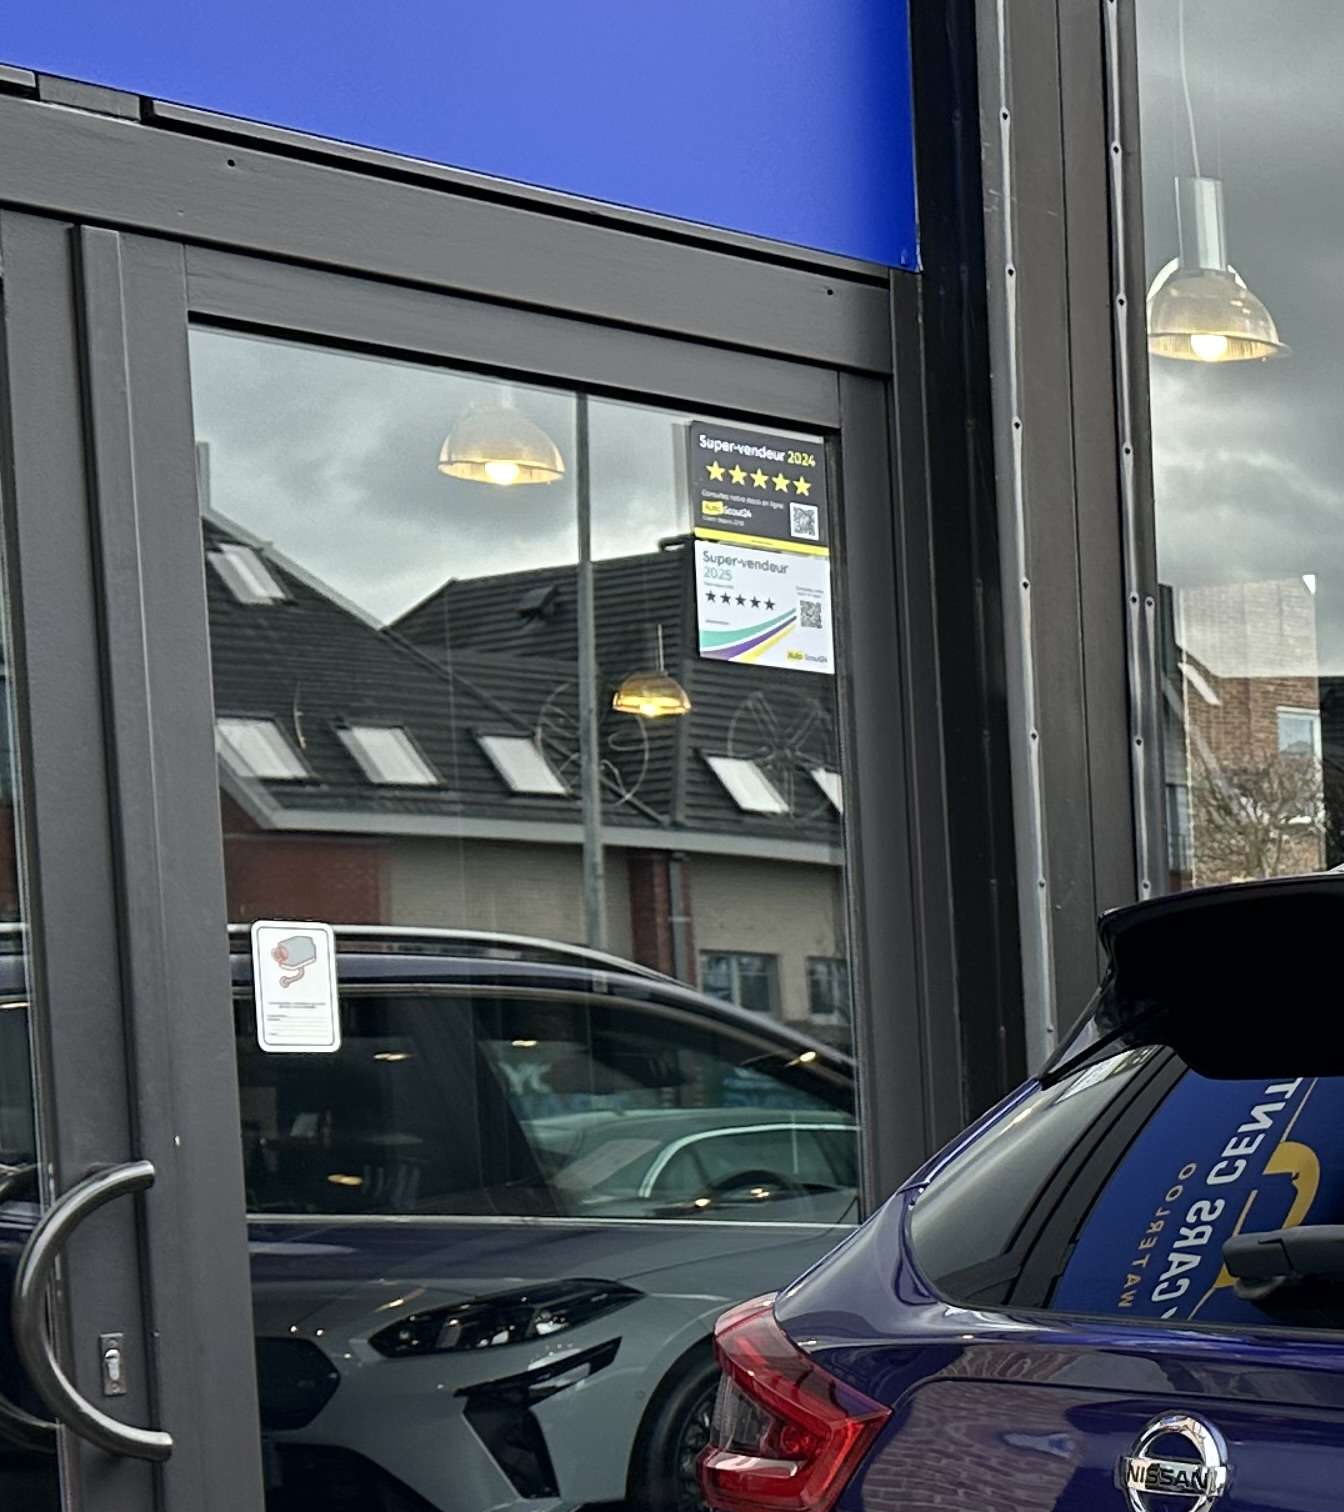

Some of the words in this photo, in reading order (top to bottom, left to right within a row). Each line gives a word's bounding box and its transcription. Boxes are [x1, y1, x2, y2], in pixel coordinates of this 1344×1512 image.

[700, 434, 785, 462] Super-vendeur
[787, 450, 817, 467] 2024
[702, 550, 789, 574] Super-vendeur
[704, 566, 732, 581] 2025
[1128, 1462, 1210, 1490] NISSAN
